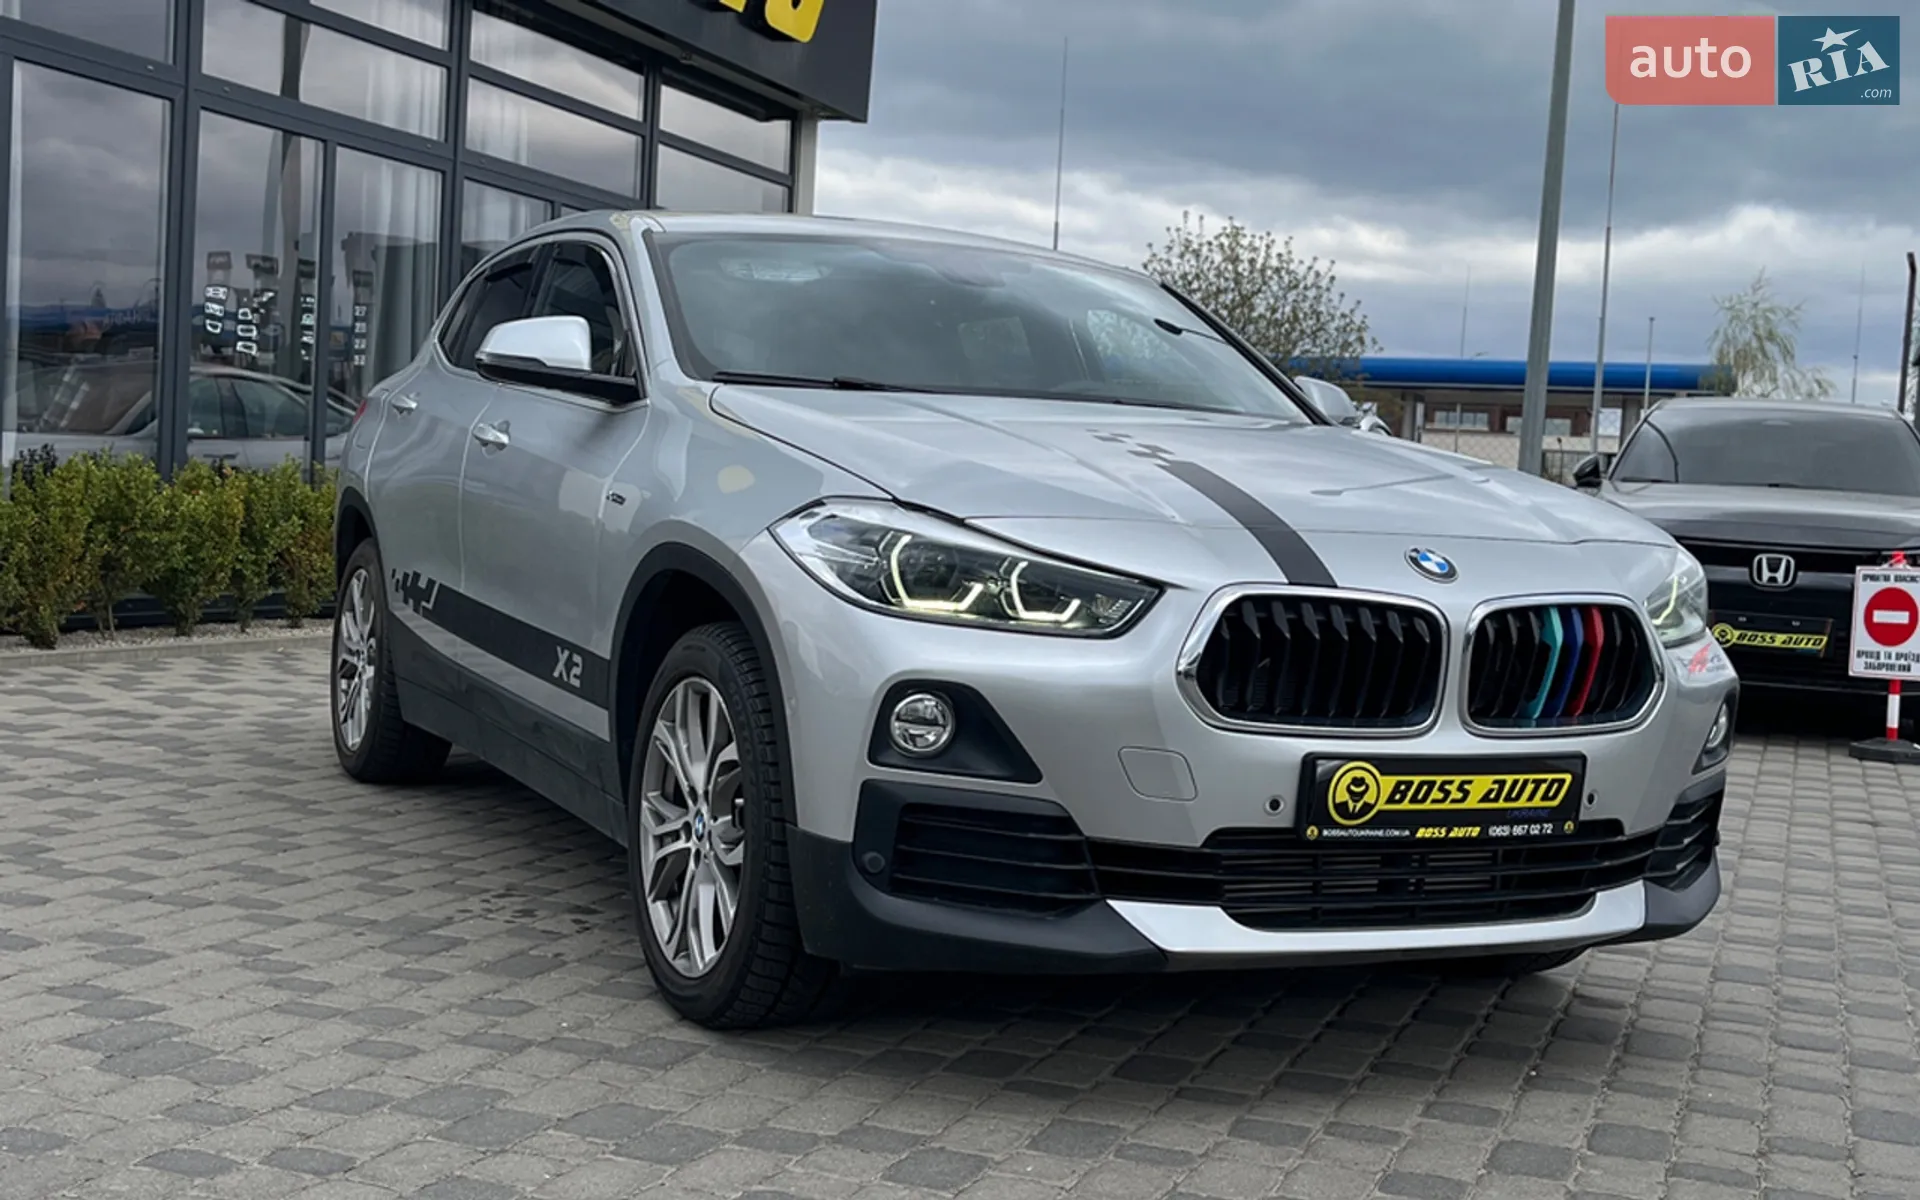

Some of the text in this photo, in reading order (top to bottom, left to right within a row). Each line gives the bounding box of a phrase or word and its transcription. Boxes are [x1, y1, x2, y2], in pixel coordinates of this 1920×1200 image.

[1736, 632, 1824, 647] BOSS AUTO
[553, 646, 583, 688] X2
[1385, 777, 1569, 805] BOSS AUTO
[1415, 826, 1481, 838] BOSS AUTO
[1542, 823, 1554, 835] 72
